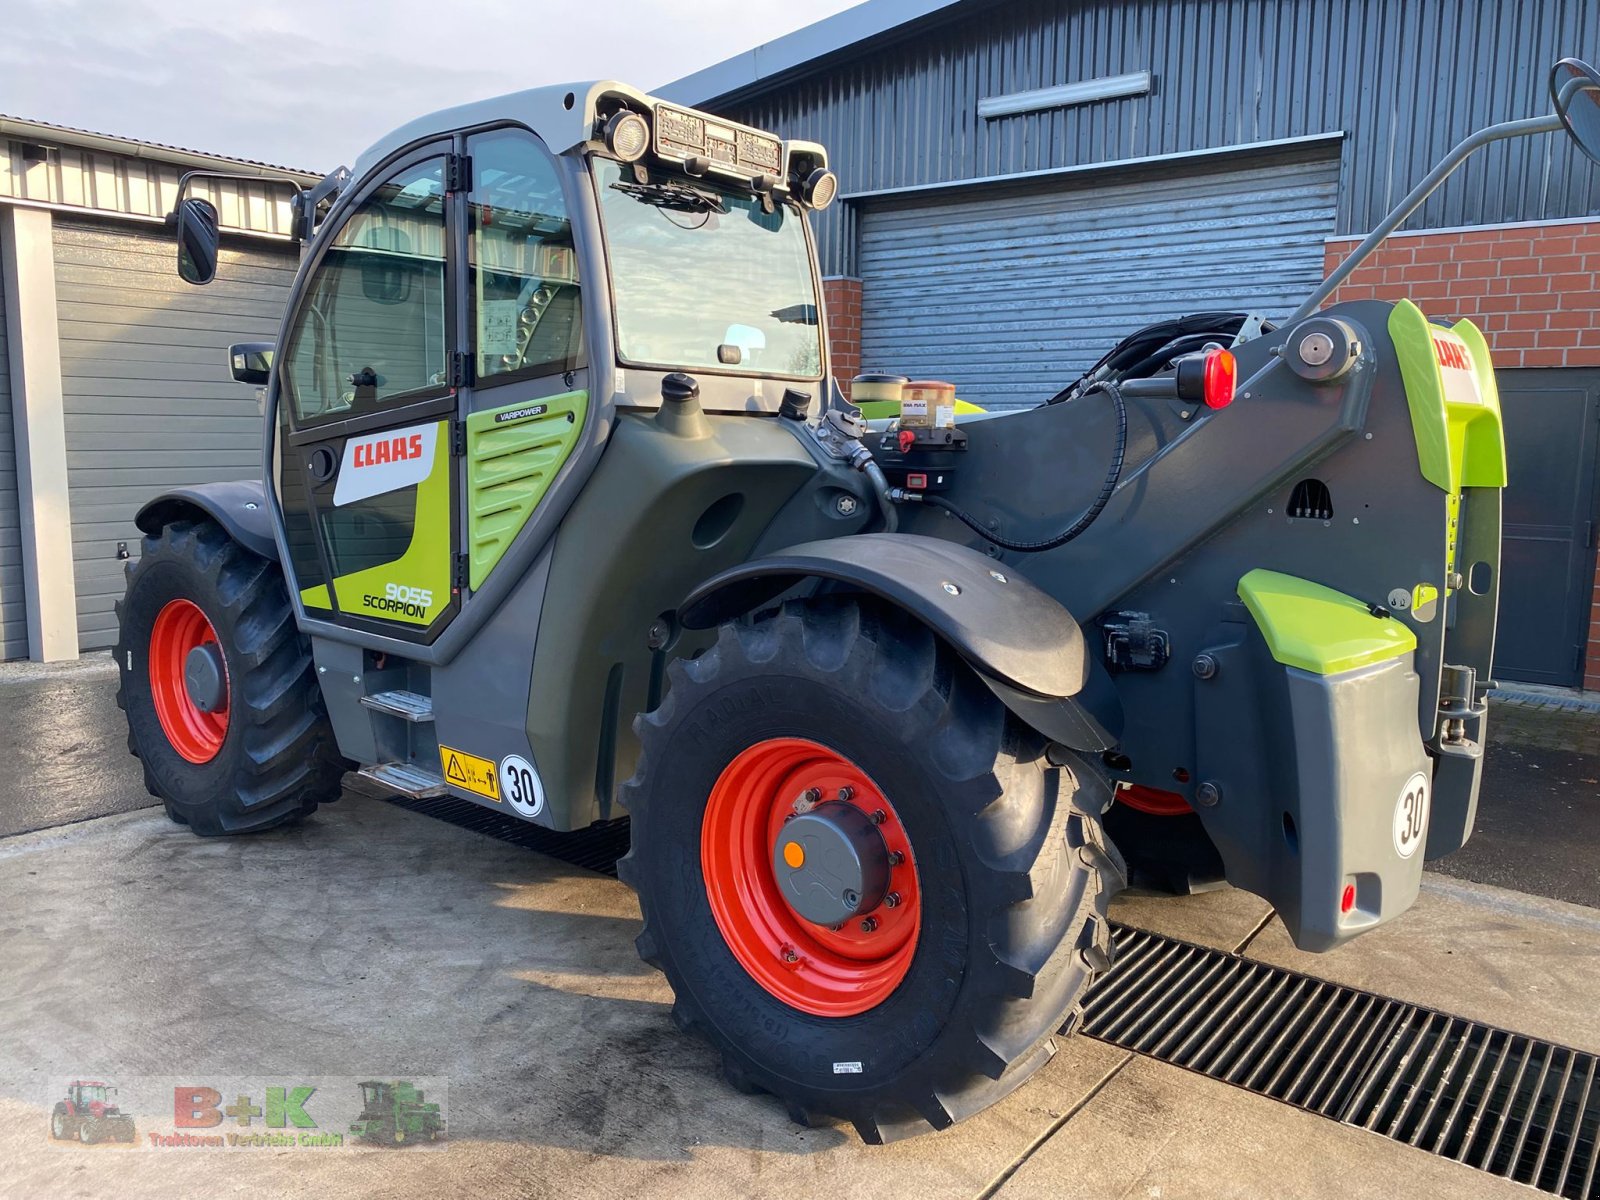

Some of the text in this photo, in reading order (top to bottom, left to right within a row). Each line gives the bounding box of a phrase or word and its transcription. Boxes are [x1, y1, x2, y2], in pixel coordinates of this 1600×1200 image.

[1433, 338, 1472, 370] LAAS
[500, 406, 541, 421] VARIPOWER
[353, 434, 422, 468] CLAAS
[363, 594, 426, 619] SCORPION
[385, 583, 433, 607] 9055
[507, 765, 536, 807] 30
[1402, 787, 1424, 845] 30
